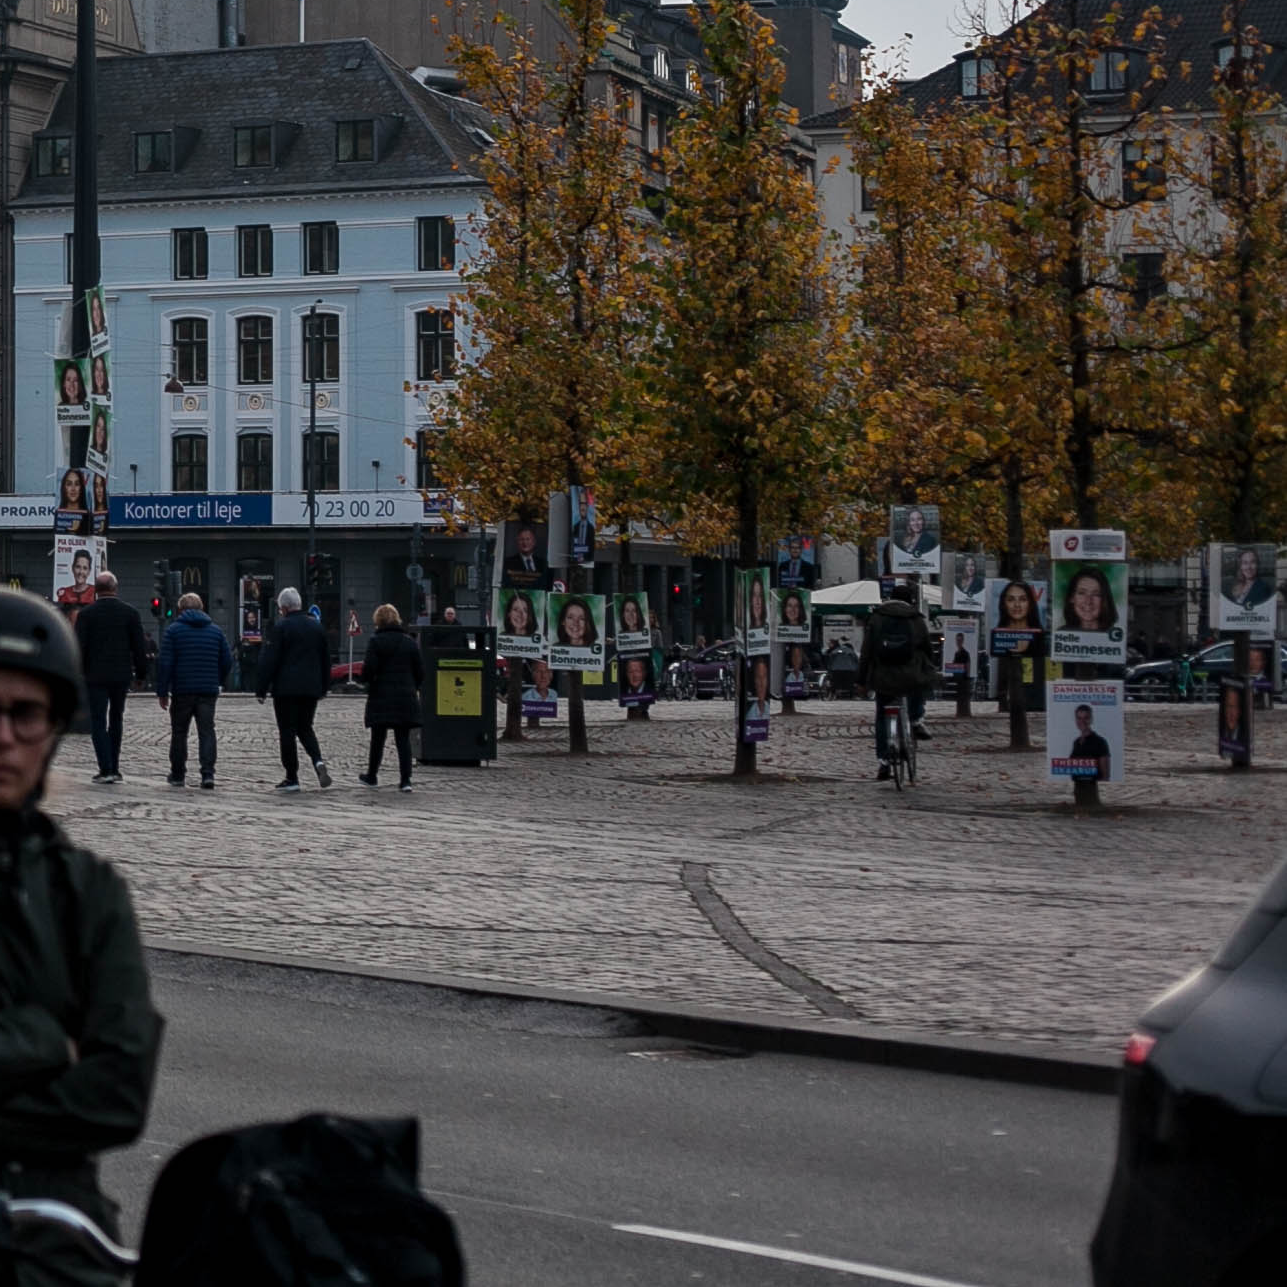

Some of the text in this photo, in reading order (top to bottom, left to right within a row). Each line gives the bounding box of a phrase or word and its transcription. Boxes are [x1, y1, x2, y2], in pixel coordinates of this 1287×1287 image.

[1, 506, 54, 517] PROARK
[125, 500, 242, 523] Kontorer til leje
[301, 499, 395, 518] 70 23 00 20
[1054, 634, 1080, 643] Helle
[497, 643, 540, 654] Bonnesen
[1054, 643, 1121, 656] Bonnesen
[551, 655, 601, 666] Bonnesen
